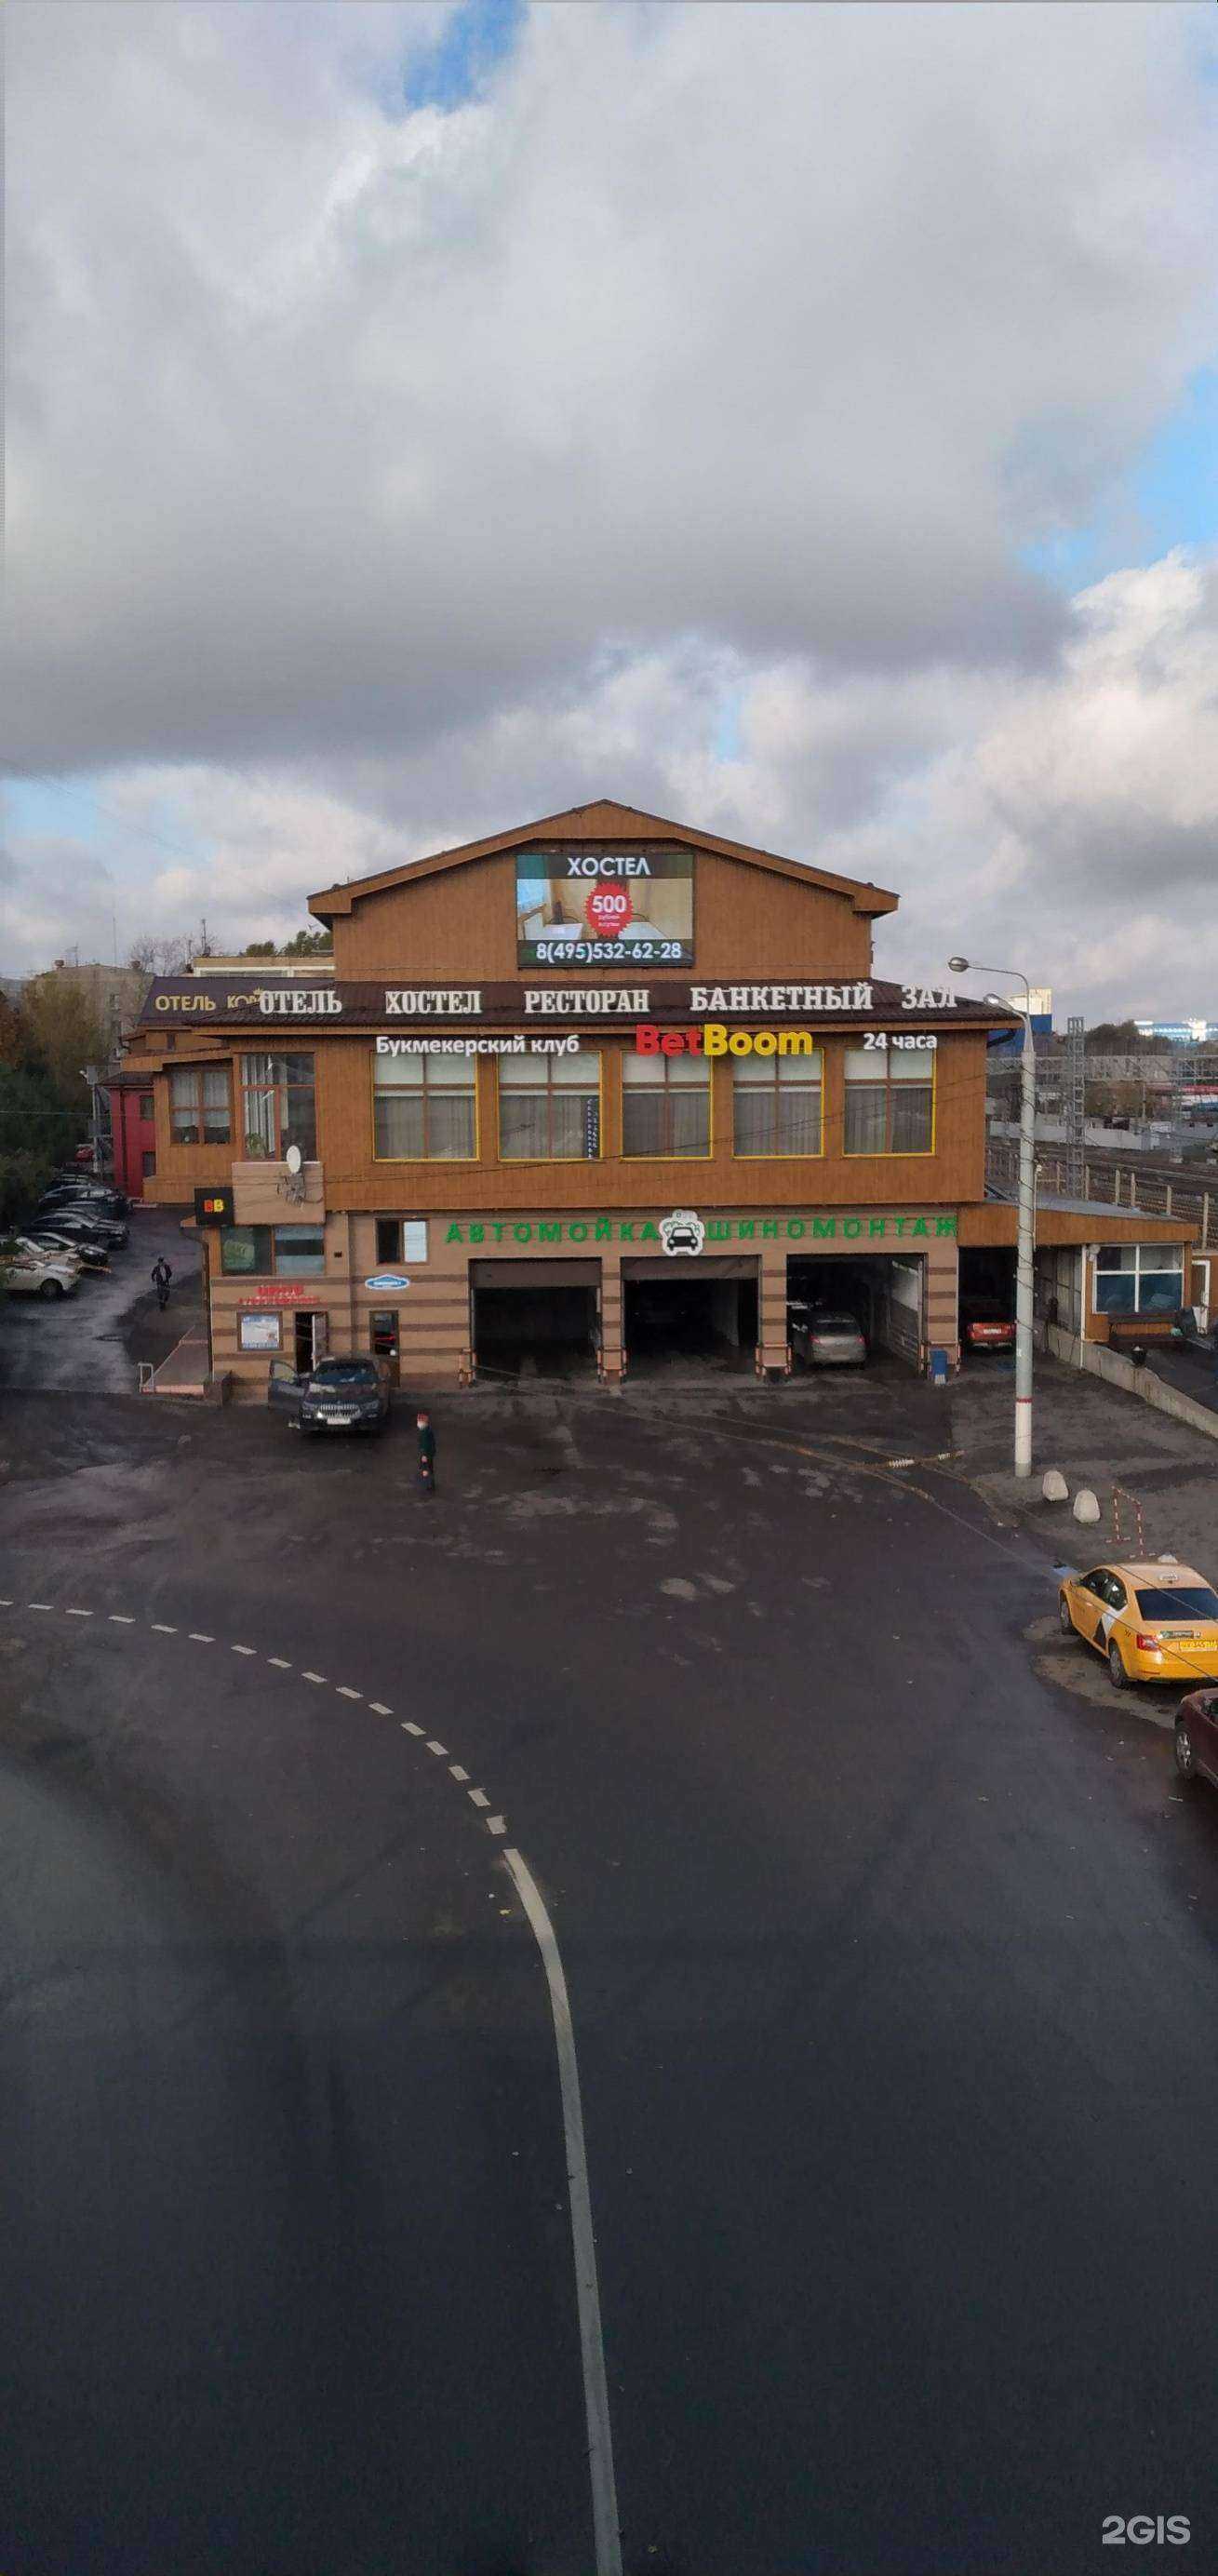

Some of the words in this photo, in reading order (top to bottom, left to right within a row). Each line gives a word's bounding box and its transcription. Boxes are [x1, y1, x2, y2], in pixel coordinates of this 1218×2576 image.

[567, 857, 651, 876] ХОСТЕЛ
[591, 894, 627, 913] 500
[536, 942, 682, 963] 8(495)532-62-28
[154, 995, 216, 1011] ОТЕЛЬ
[260, 989, 342, 1013] ОТЕЛЬ
[384, 990, 482, 1014] ХОСТЕЛ
[524, 989, 649, 1013] РЕСТОРАН
[689, 982, 874, 1011] БАНКЕТНЫЙ
[901, 984, 958, 1010] ЗАЛ
[375, 1035, 525, 1056] Букмекерский
[530, 1034, 580, 1056] клуб
[636, 1024, 813, 1056] BetBoom
[863, 1033, 886, 1050] 24
[892, 1034, 938, 1050] часа
[445, 1217, 660, 1244] АВТОМОЙКА
[703, 1216, 958, 1241] ШИНОМОНТАЖ
